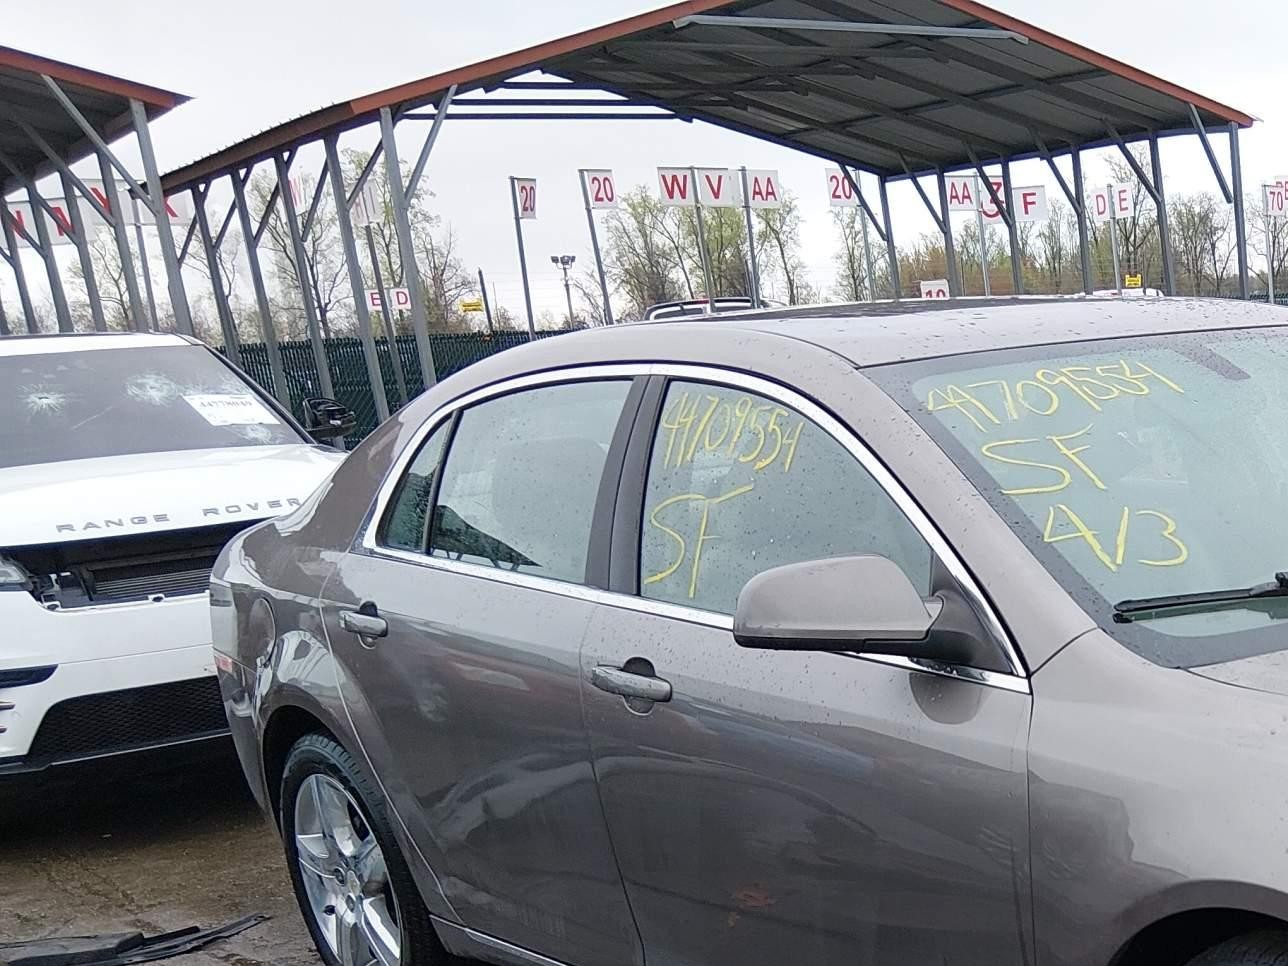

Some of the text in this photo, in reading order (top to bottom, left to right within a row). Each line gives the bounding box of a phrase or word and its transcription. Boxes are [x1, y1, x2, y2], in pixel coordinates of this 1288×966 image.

[520, 185, 536, 212] 20
[591, 176, 614, 202] 20
[661, 174, 723, 199] W V
[752, 176, 778, 201] AA
[830, 175, 852, 200] 20
[950, 182, 973, 205] AA
[1022, 192, 1037, 215] F
[1095, 189, 1129, 216] D E
[370, 291, 409, 306] E D
[981, 423, 1109, 496] SF
[55, 497, 302, 534] RANGE ROVER
[643, 482, 754, 599] SF
